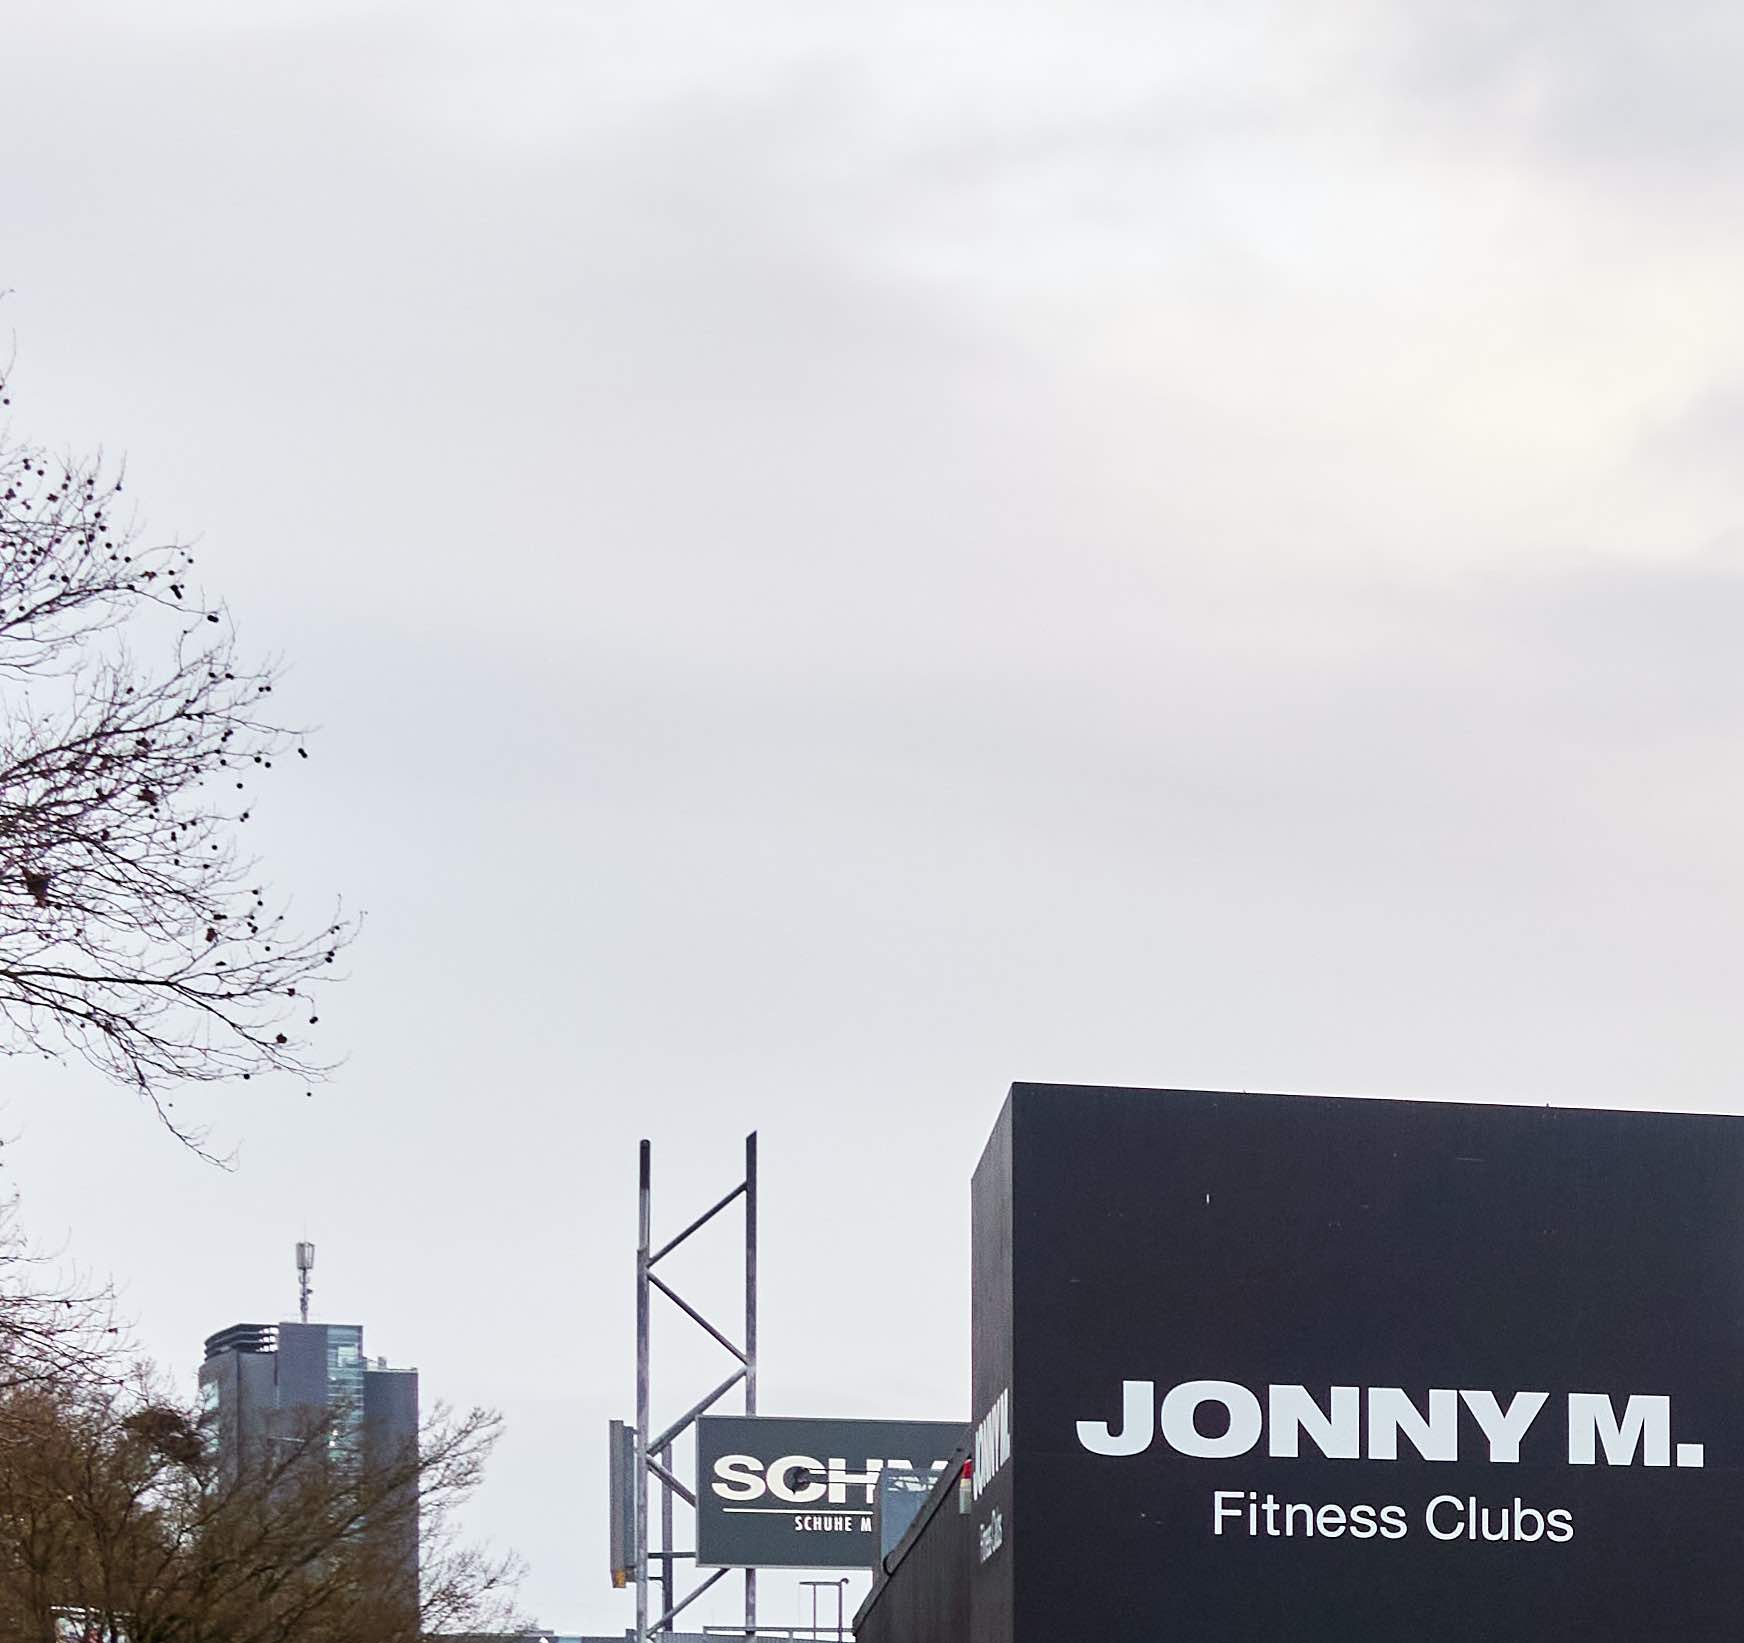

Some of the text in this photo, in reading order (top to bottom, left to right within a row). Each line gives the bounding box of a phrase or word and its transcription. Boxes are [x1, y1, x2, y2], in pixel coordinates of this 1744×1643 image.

[1076, 1380, 1705, 1467] JONNY M.
[794, 1515, 853, 1532] SCHUHE
[1213, 1491, 1575, 1542] Fitness Clubs
